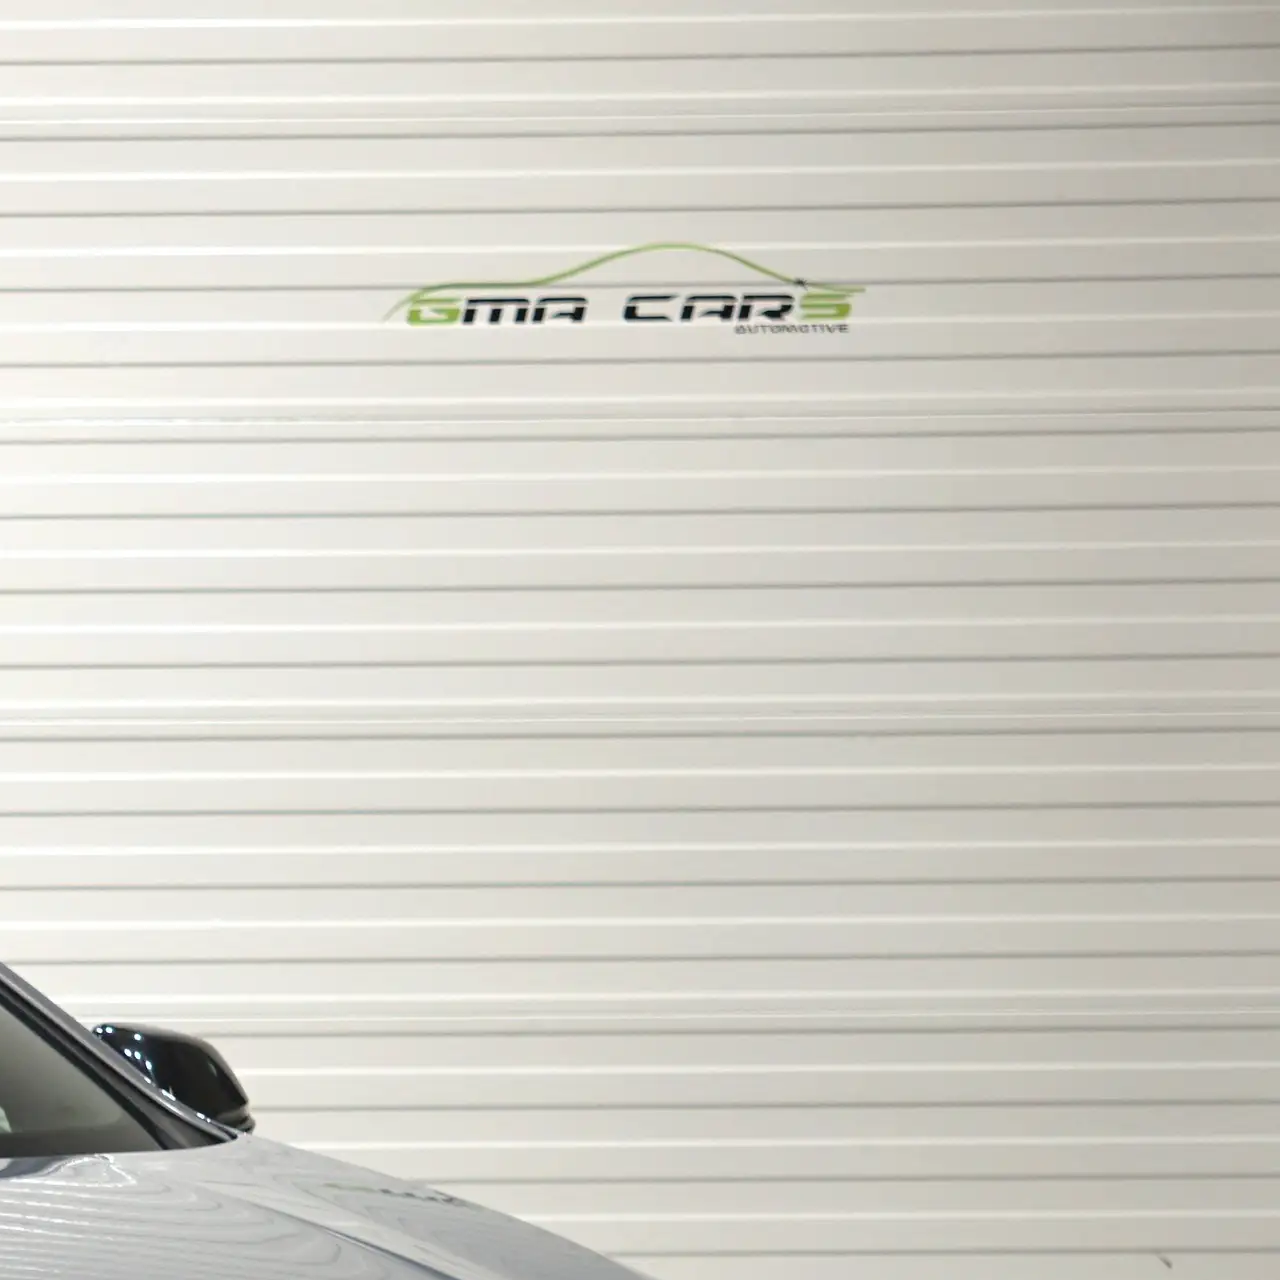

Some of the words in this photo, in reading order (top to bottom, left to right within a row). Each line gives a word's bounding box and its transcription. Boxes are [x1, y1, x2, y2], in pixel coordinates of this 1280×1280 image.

[407, 295, 587, 325] GMA
[623, 292, 852, 323] CARS
[734, 324, 850, 335] AUTOMOTIVE
